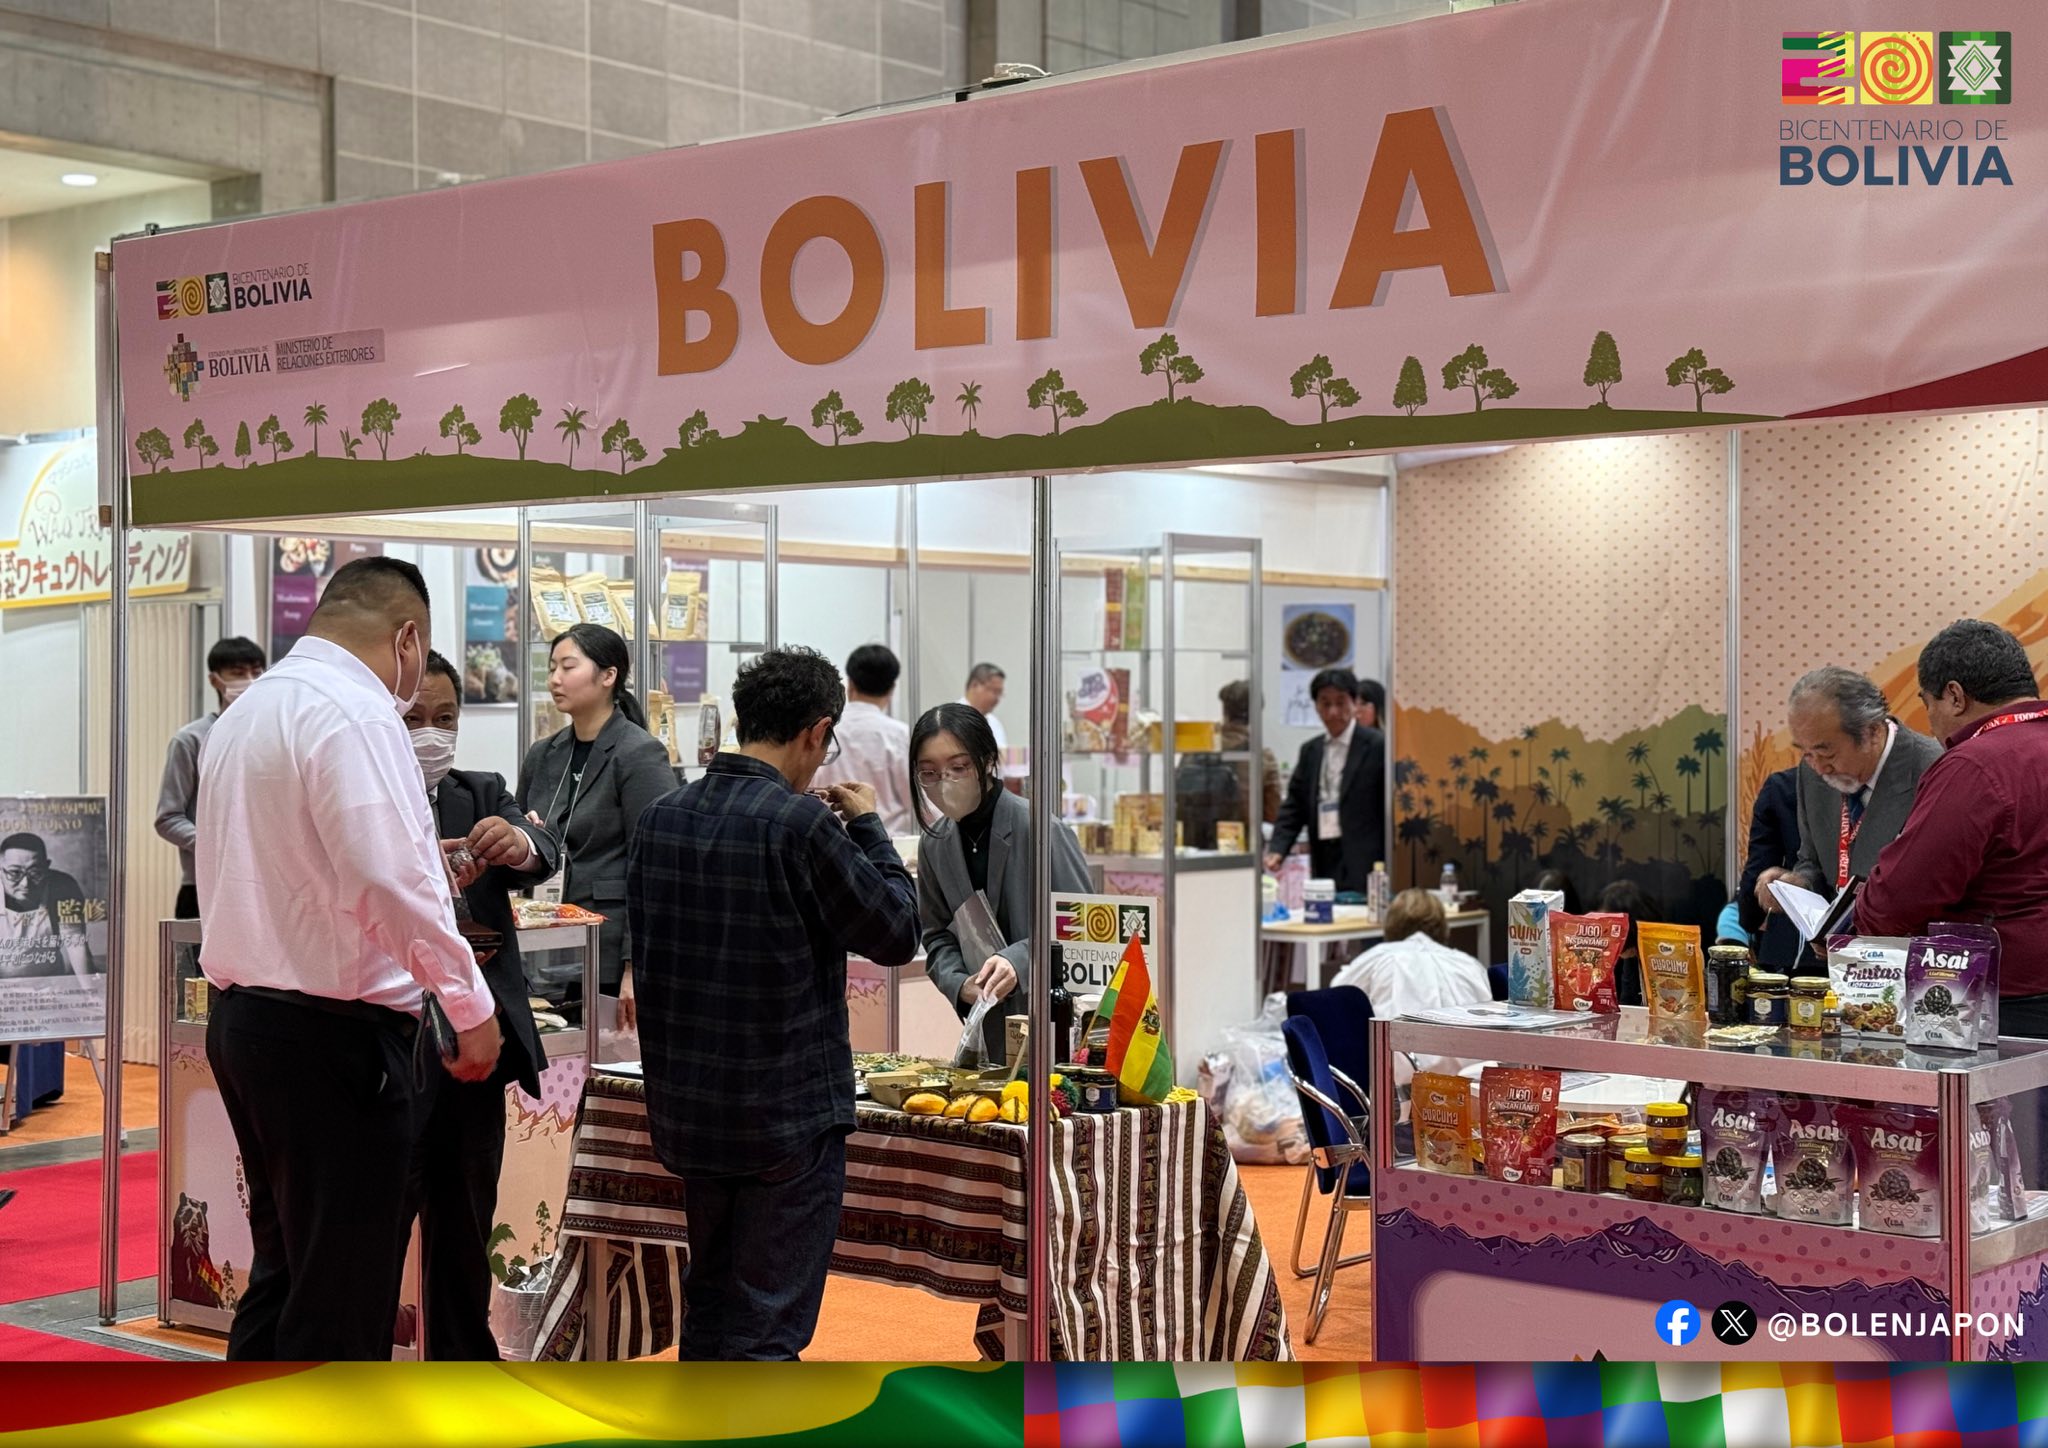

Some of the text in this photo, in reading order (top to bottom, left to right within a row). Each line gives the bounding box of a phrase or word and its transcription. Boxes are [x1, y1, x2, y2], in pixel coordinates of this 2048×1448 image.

[652, 107, 1508, 376] BOLIVIA
[232, 262, 309, 285] BICENTENARIO DE
[234, 278, 312, 309] BOLIVIA
[276, 336, 334, 356] MINISTERIO DE
[277, 346, 375, 371] RELACIONES EXTERIORES
[209, 353, 271, 378] BOLIVIA
[17, 535, 190, 595] ワキュウトレディング
[57, 898, 106, 924] 監修
[1577, 925, 1600, 937] JUGO
[1920, 947, 1970, 970] Asai
[1843, 963, 1902, 982] Frutas
[1508, 1089, 1531, 1101] JUGO
[1711, 1107, 1756, 1132] Asai
[1789, 1119, 1841, 1142] Asai
[1871, 1127, 1923, 1152] Asai
